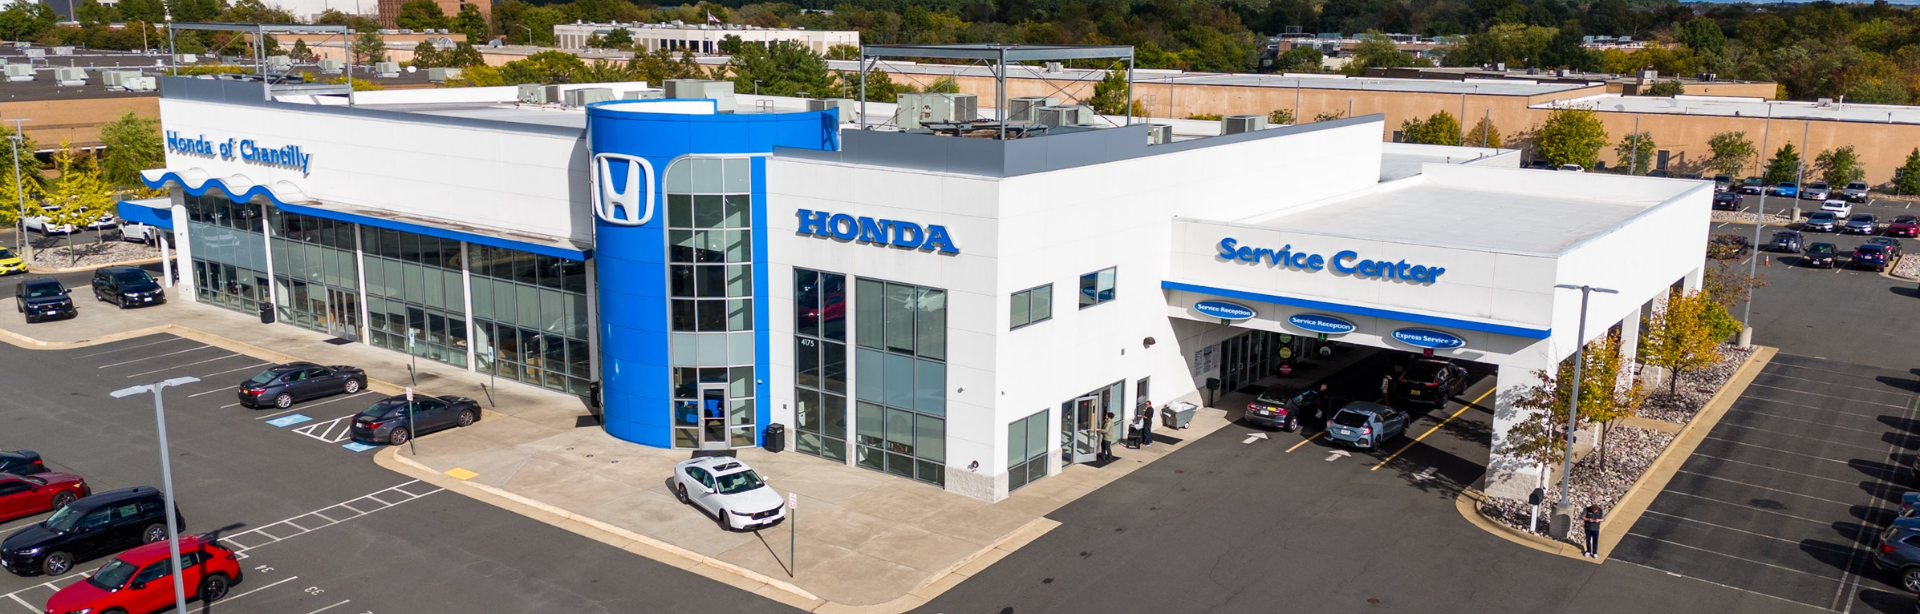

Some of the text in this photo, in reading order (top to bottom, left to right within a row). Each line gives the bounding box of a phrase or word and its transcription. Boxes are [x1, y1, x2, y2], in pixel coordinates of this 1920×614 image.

[166, 130, 311, 174] Honda of Chantilly
[796, 208, 960, 254] HONDA
[1219, 237, 1446, 283] Service Center
[1197, 303, 1251, 316] Service Reception
[1292, 316, 1350, 330] Service Reception
[801, 339, 815, 347] 4175
[1395, 331, 1449, 344] Express Service
[304, 586, 325, 596] 33
